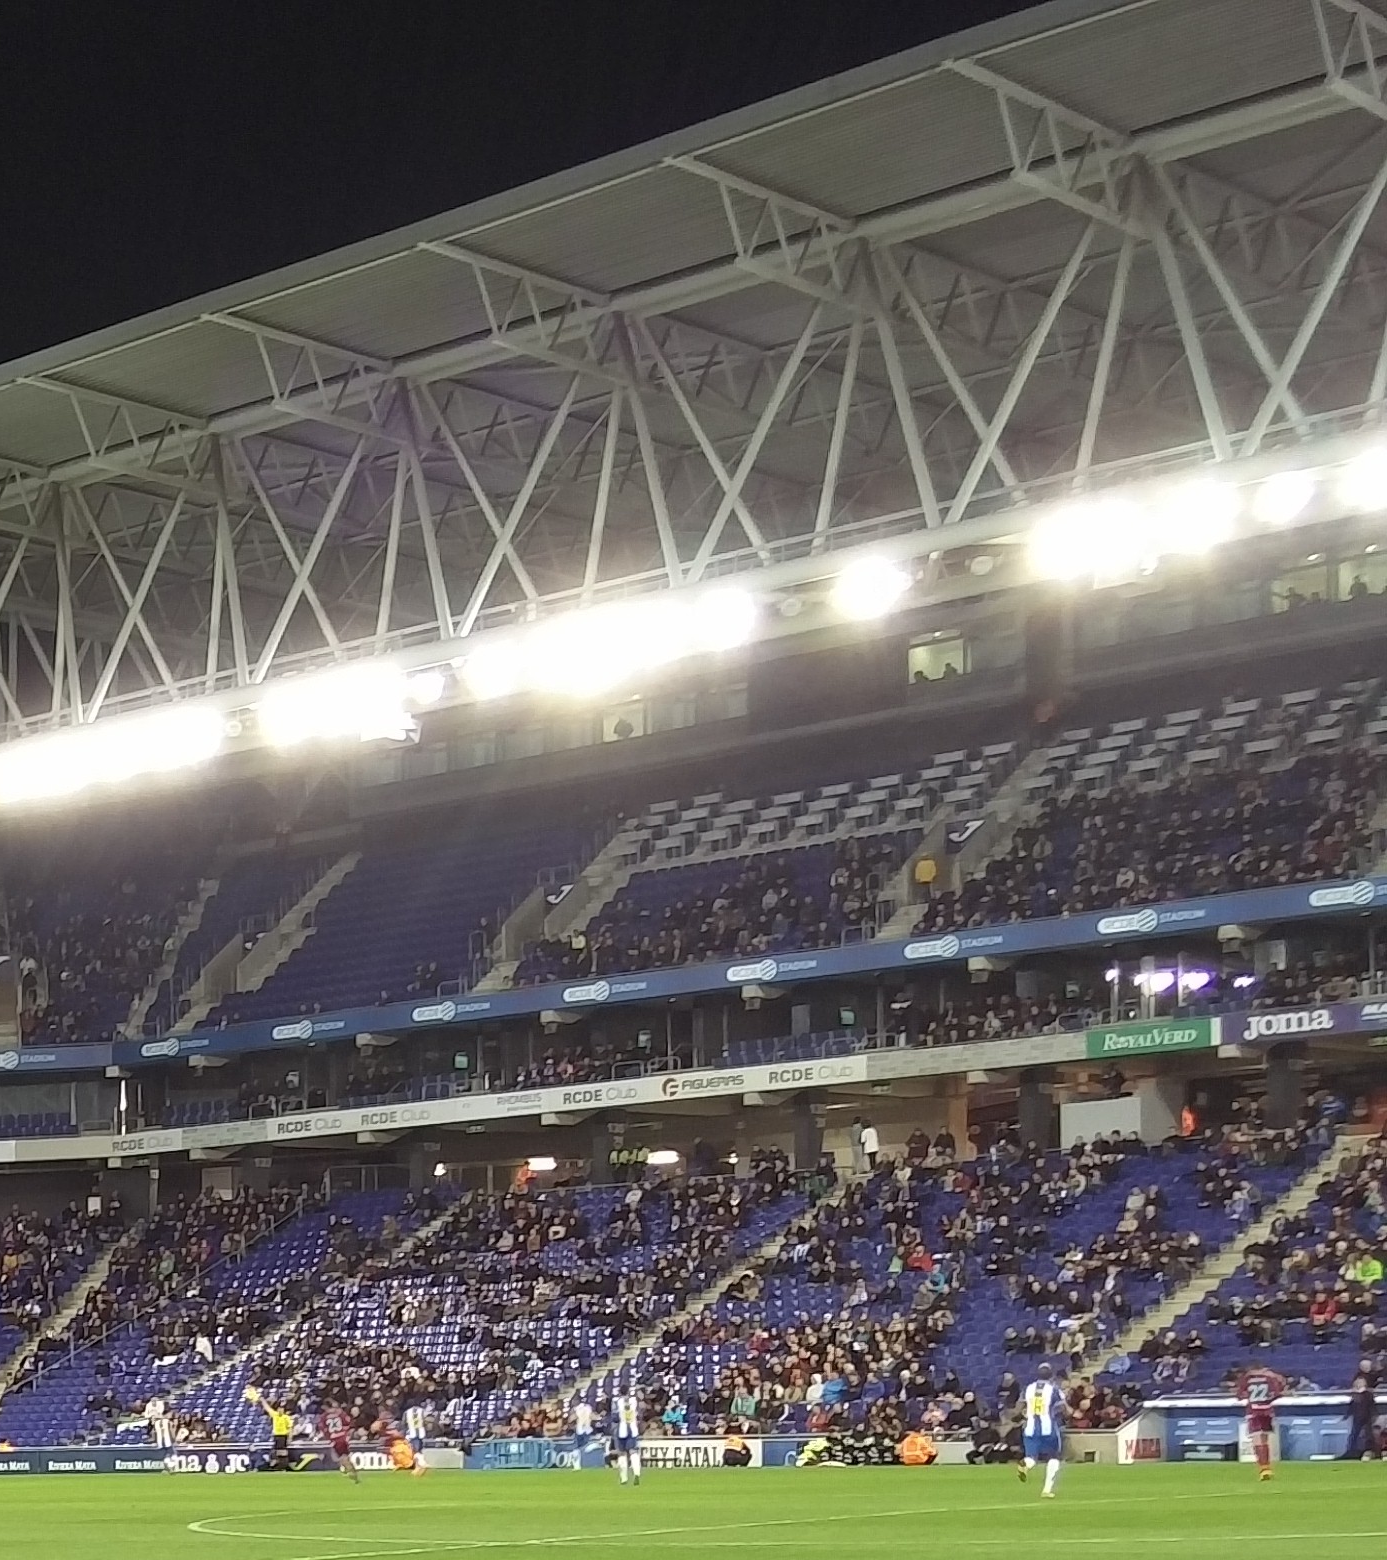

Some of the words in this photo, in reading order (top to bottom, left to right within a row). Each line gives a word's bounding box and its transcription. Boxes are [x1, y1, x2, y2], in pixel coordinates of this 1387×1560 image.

[768, 1067, 814, 1084] RCDE
[563, 1089, 603, 1105] RCDE
[361, 1110, 398, 1126] RCDE
[277, 1119, 312, 1134] RCDE
[112, 1137, 145, 1153] RCDE
[676, 1447, 724, 1467] CATAL
